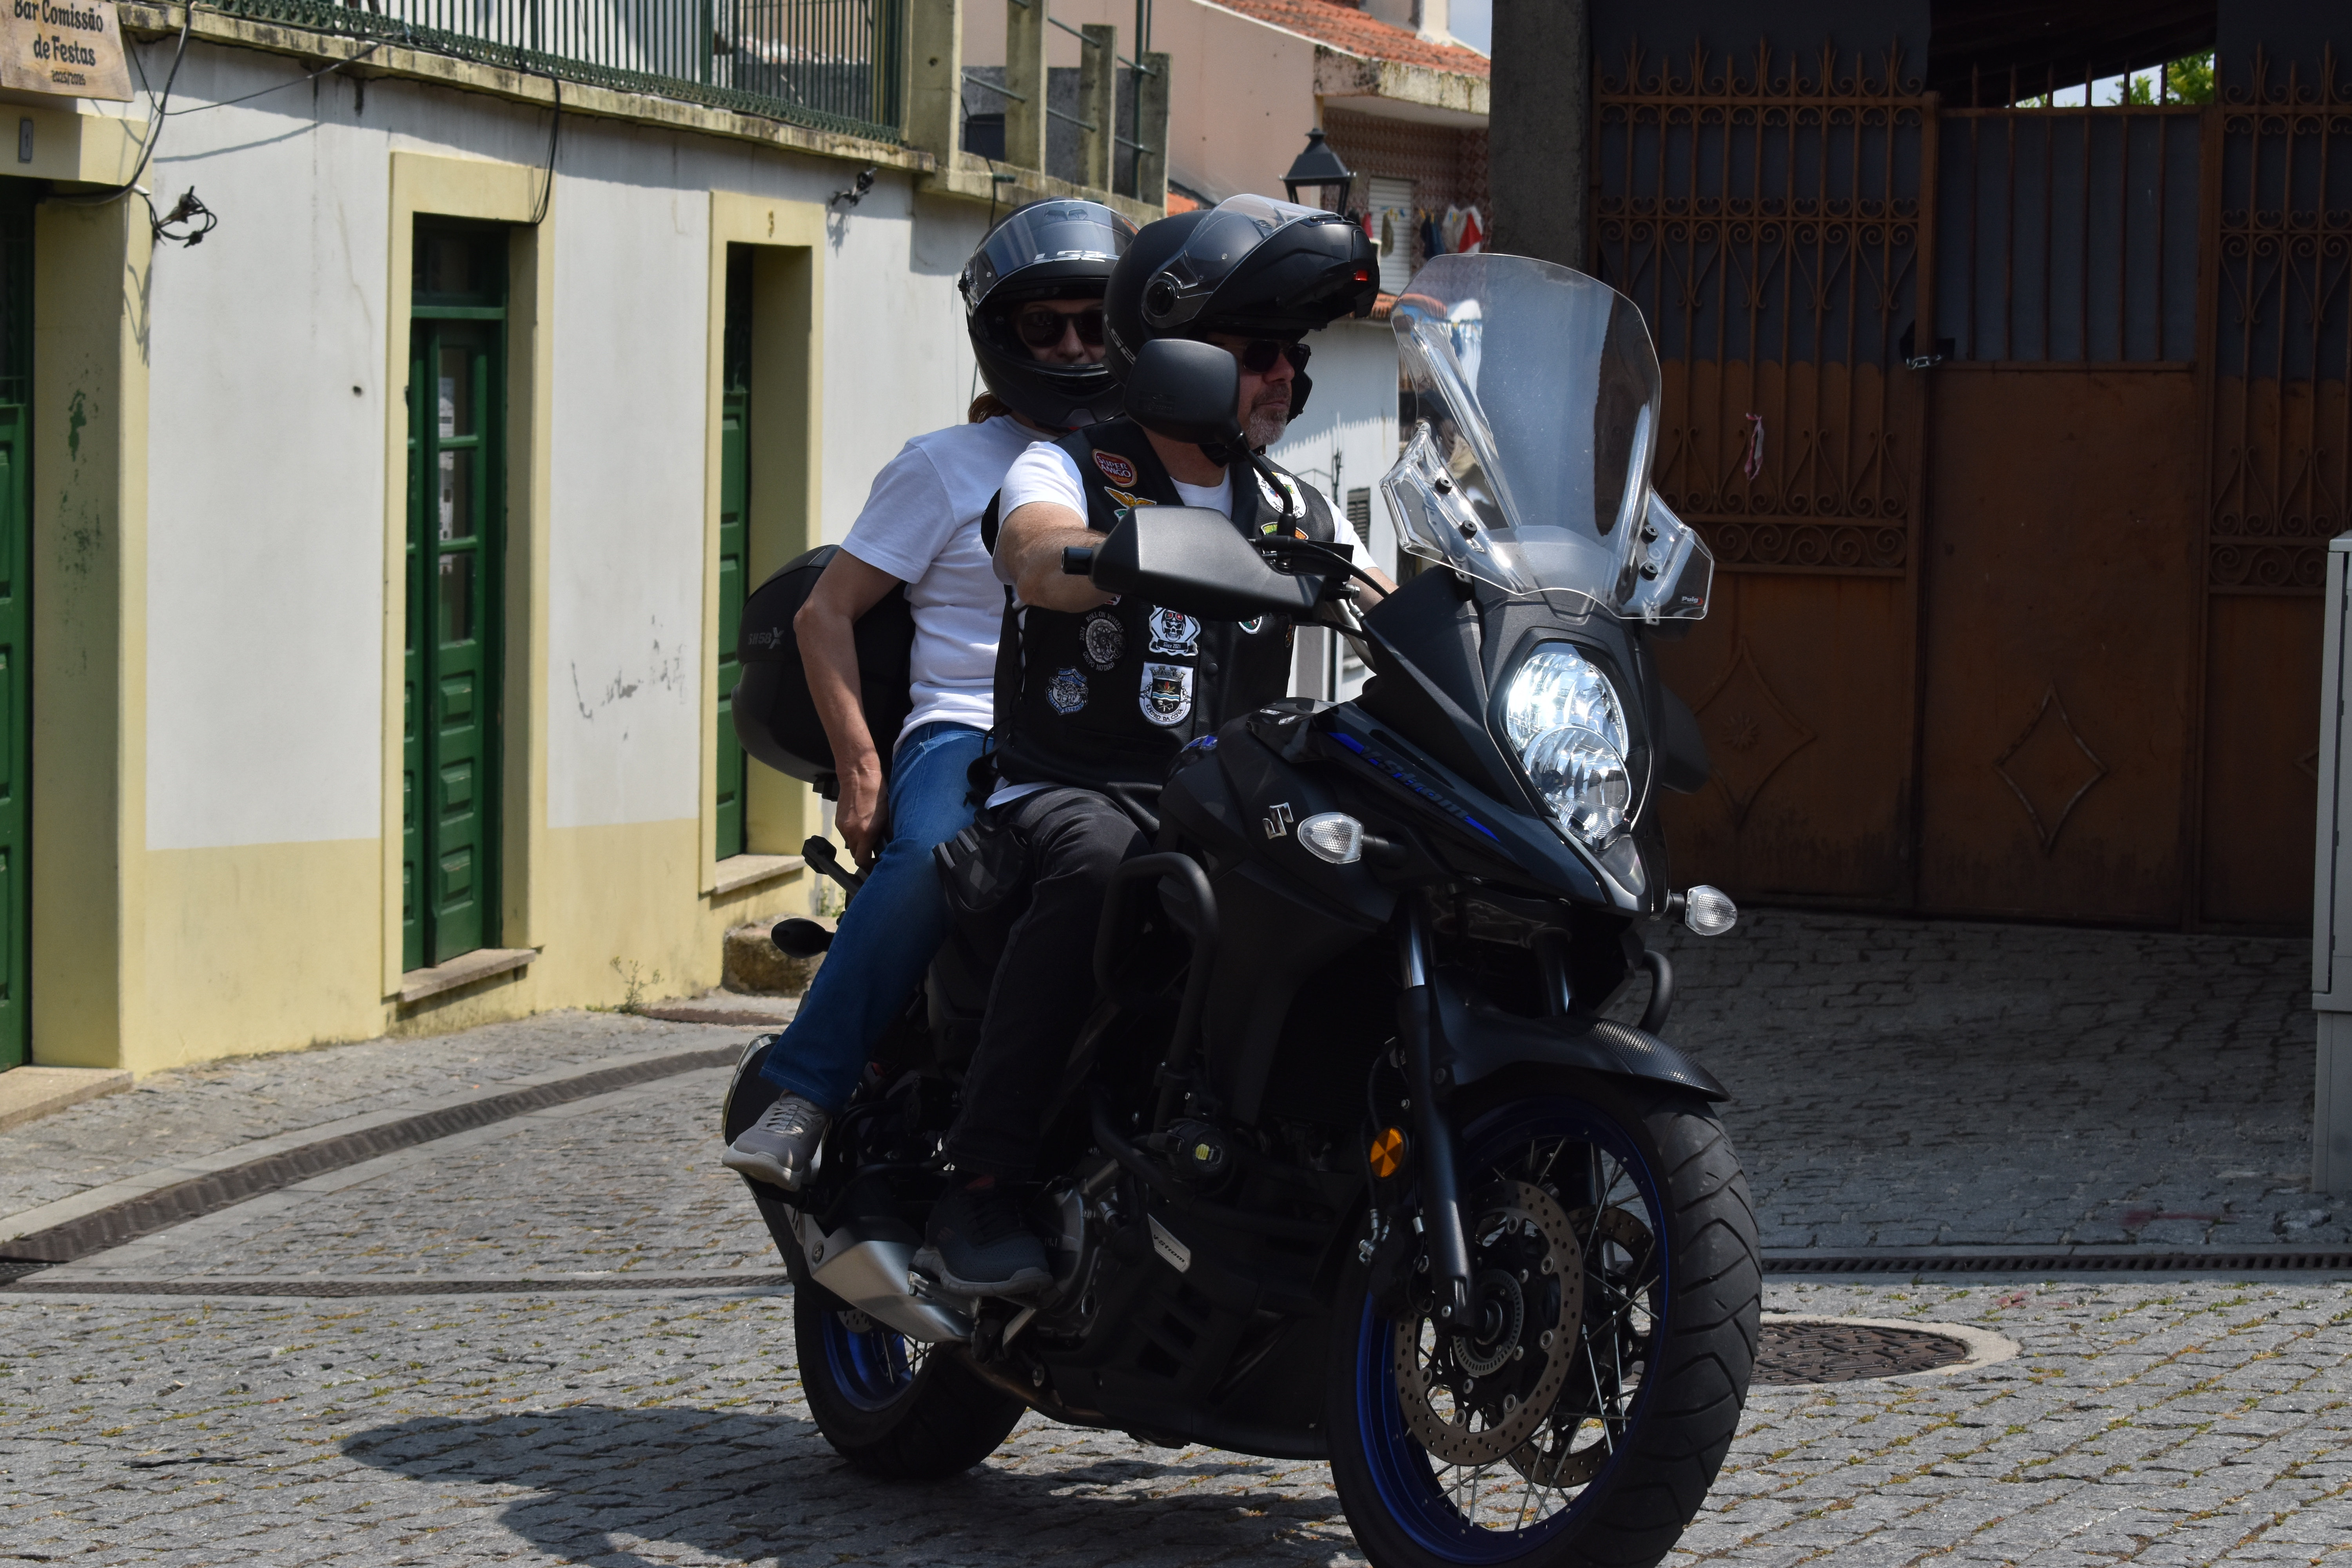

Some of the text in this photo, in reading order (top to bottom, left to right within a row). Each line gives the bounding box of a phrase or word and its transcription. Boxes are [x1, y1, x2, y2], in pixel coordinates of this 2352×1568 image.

[15, 0, 103, 32] Bar Comissão
[33, 33, 96, 66] de Festas
[1103, 314, 1136, 365] LS2
[1097, 456, 1128, 470] SUPER
[1101, 464, 1131, 477] AMIGO
[1085, 612, 1098, 622] ROLL
[1107, 613, 1124, 633] WHEELS
[1083, 651, 1115, 671] GRUPO MOTARD
[1171, 709, 1183, 719] COVA
[1154, 1234, 1185, 1262] V-Strom
